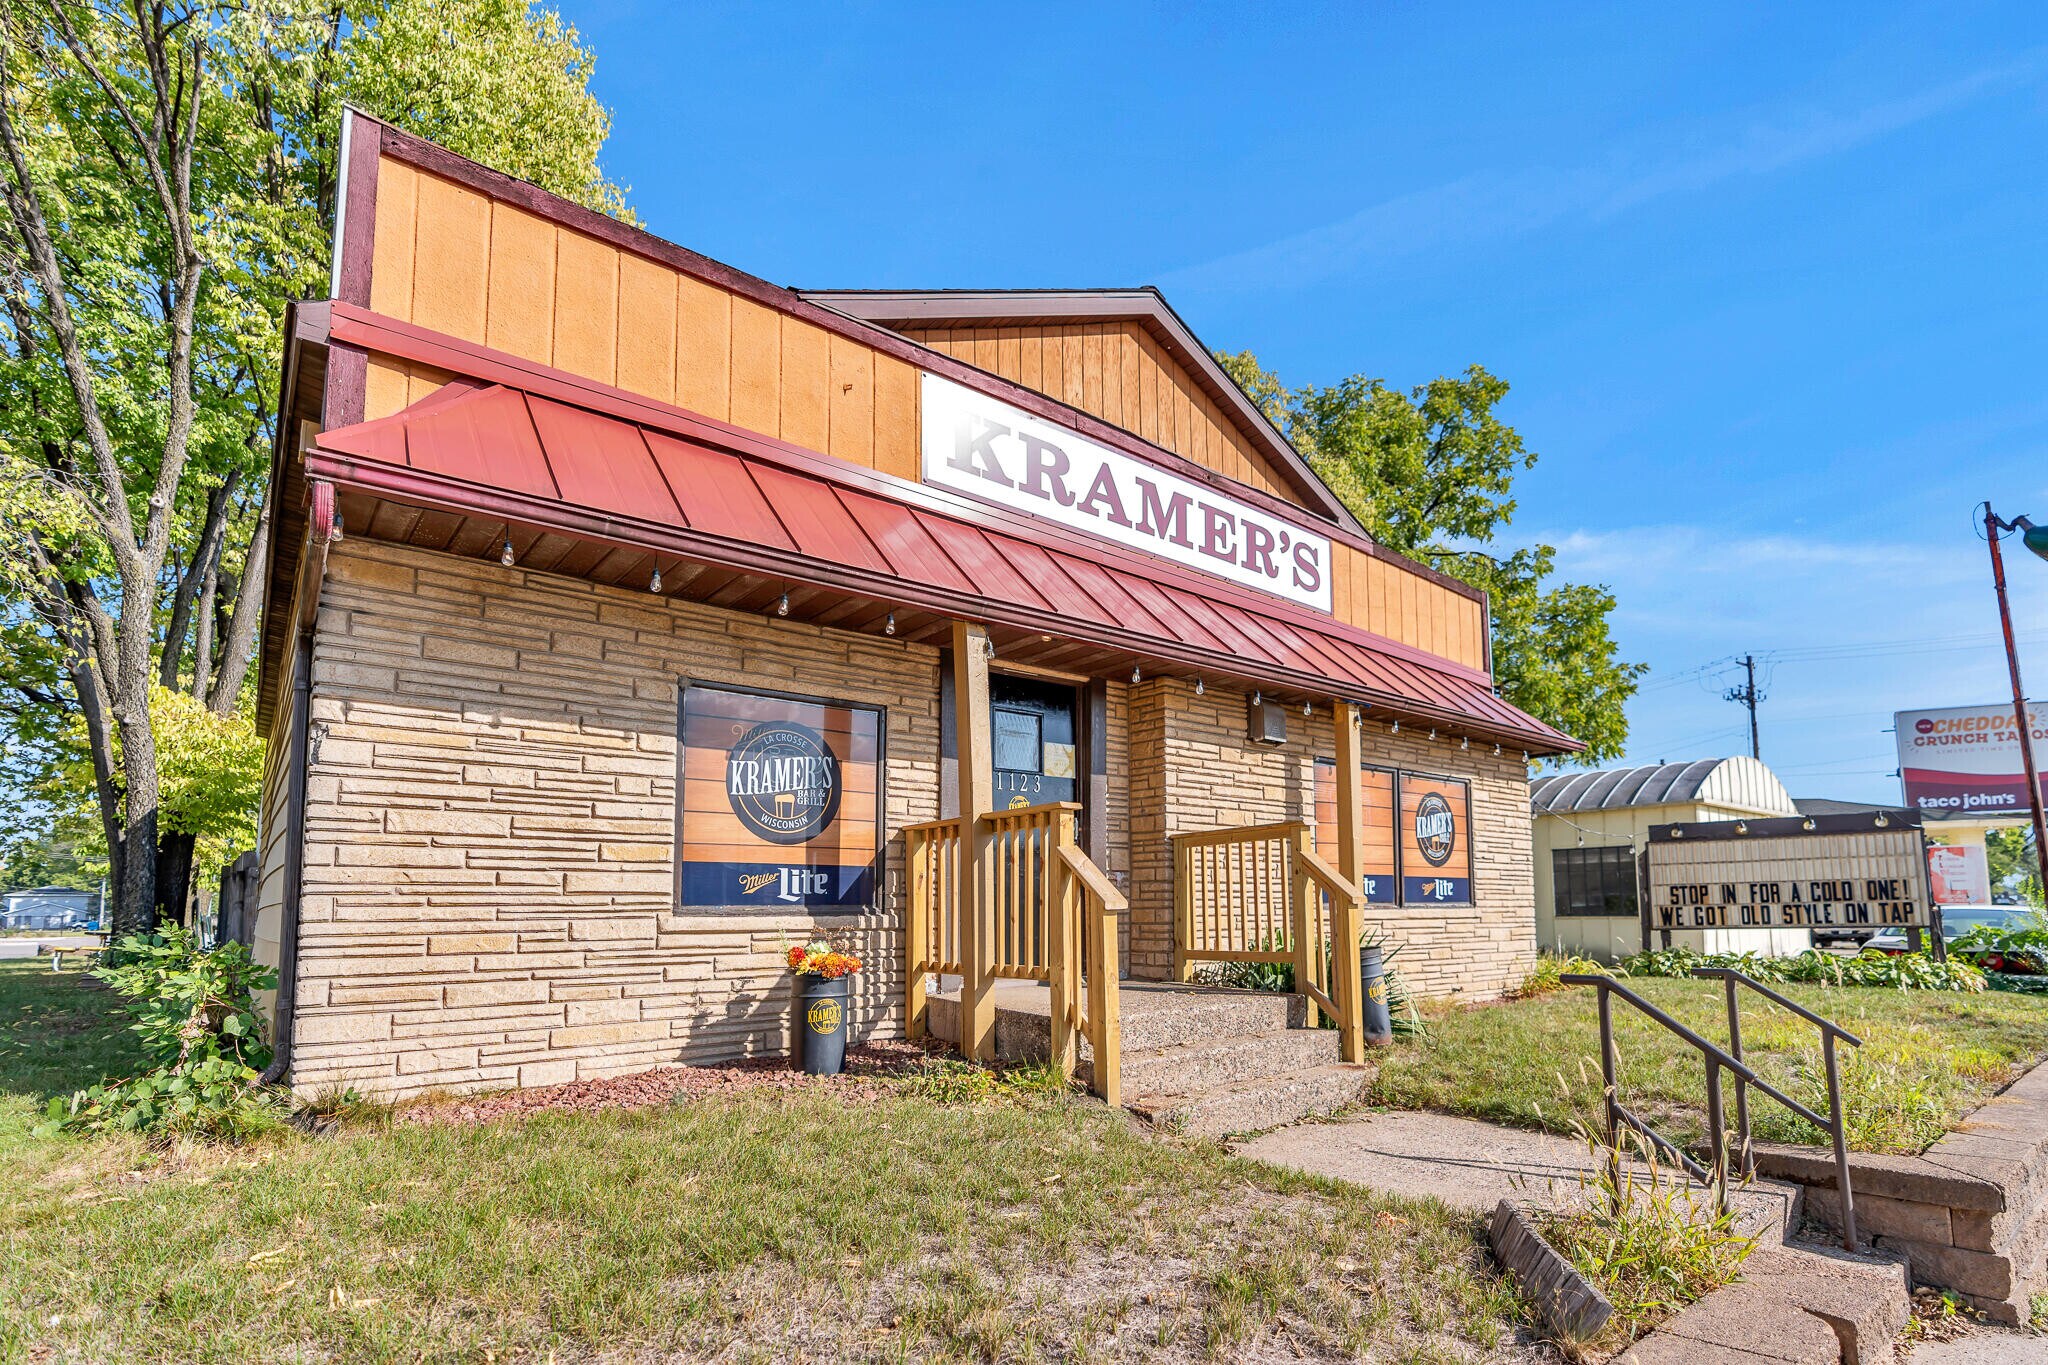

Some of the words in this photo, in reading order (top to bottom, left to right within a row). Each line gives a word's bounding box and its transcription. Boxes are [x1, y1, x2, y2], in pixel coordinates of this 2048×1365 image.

[946, 411, 1321, 593] KRAMER'S
[763, 735, 774, 744] LA
[776, 733, 807, 748] CROSSE
[1914, 732, 1988, 747] CRUNCH
[730, 756, 832, 795] KRAMER'S
[997, 772, 1041, 792] 1123
[797, 789, 816, 797] BAR
[818, 788, 825, 797] &
[797, 798, 824, 806] GRILL
[1918, 796, 1960, 808] taco
[1963, 793, 2016, 809] john's
[761, 813, 808, 829] WISCONSIN
[1416, 812, 1452, 838] KRAMER'S
[738, 872, 780, 894] Miller
[777, 867, 828, 902] Lite
[1364, 878, 1376, 895] te
[1435, 879, 1453, 900] Lite
[1670, 884, 1708, 905] STOP
[1722, 884, 1736, 903] IN
[1750, 883, 1780, 903] FOR
[1792, 883, 1801, 902] A
[1810, 881, 1851, 901] COLD
[1867, 879, 1908, 900] ONE!
[1660, 907, 1683, 926] WE
[1695, 906, 1727, 926] GOT
[1741, 905, 1770, 924] OLD
[1783, 904, 1832, 925] STYLE
[1846, 903, 1868, 923] ON
[1878, 902, 1913, 923] TAP
